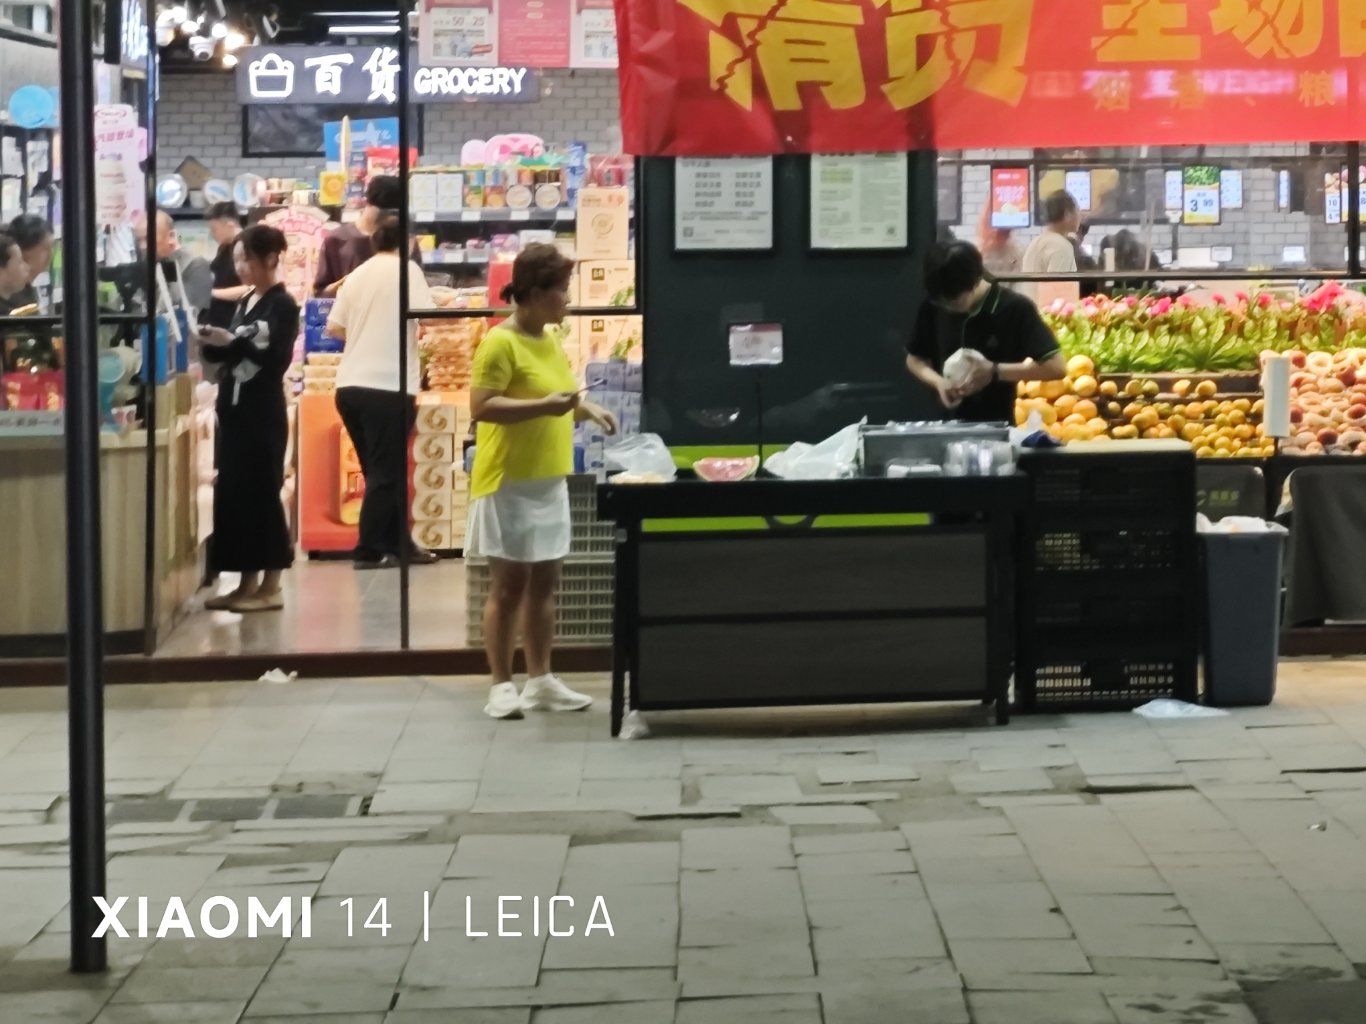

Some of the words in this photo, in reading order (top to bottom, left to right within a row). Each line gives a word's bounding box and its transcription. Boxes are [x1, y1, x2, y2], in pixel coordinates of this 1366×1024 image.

[304, 46, 402, 104] 百货
[413, 67, 527, 95] GROCERY
[1190, 199, 1199, 213] 3
